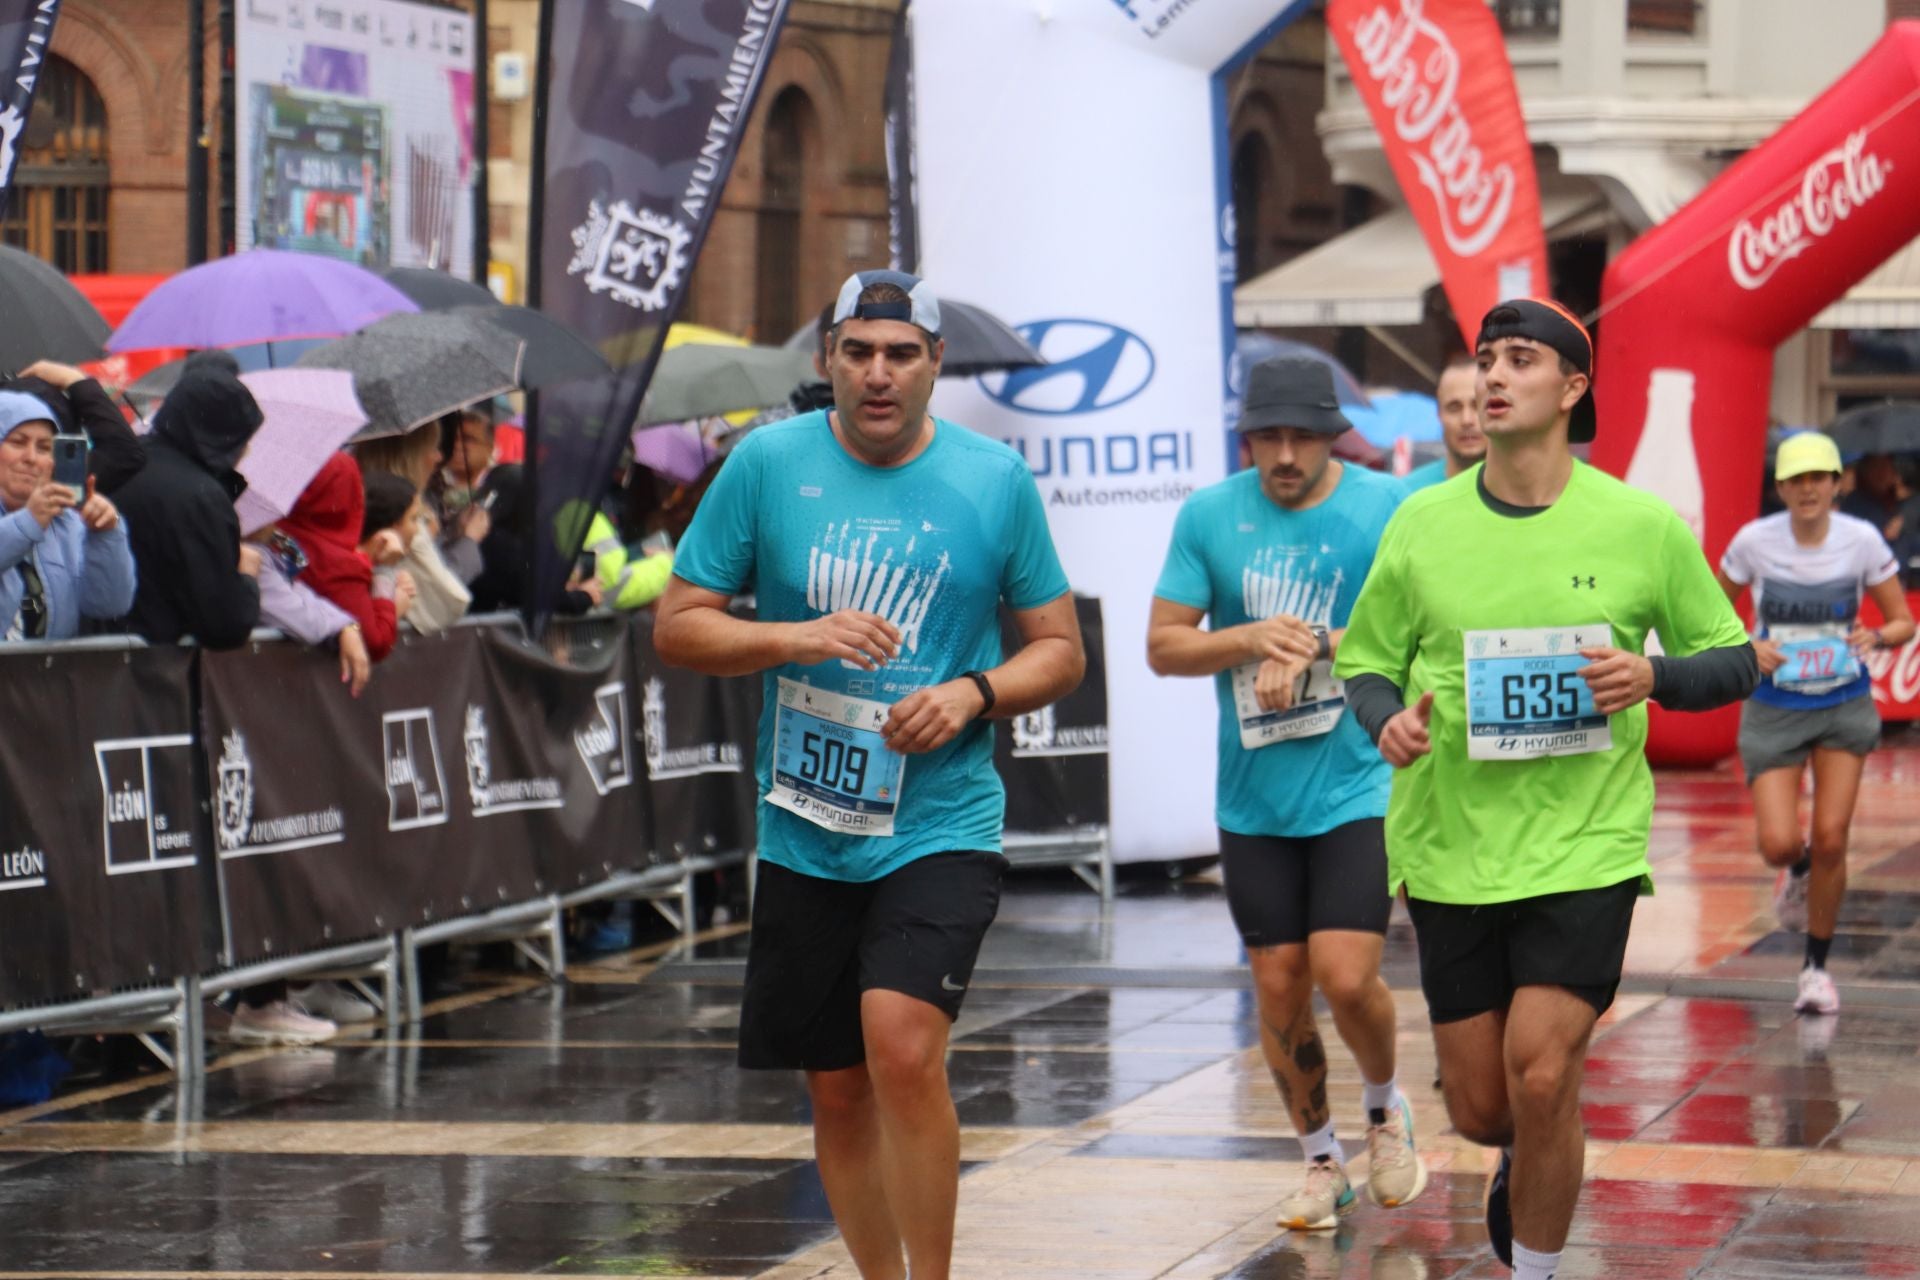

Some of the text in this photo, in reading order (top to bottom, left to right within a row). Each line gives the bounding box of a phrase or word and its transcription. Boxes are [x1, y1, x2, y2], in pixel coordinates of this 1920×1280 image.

[1728, 128, 1885, 290] Coca-Cola
[1003, 430, 1193, 477] UNDAI
[1050, 480, 1194, 507] Automoción
[1797, 647, 1835, 679] 212
[1503, 672, 1577, 720] 635
[818, 722, 855, 742] MARCOS
[1524, 732, 1588, 749] HYUNDAI
[799, 731, 869, 796] 509
[109, 780, 145, 823] LEÓN
[811, 799, 869, 826] HYUNDAI
[154, 814, 167, 830] ES
[250, 817, 308, 844] AYUNTAMIENTO
[319, 804, 342, 832] LEÓN
[3, 845, 44, 877] LEÓN
